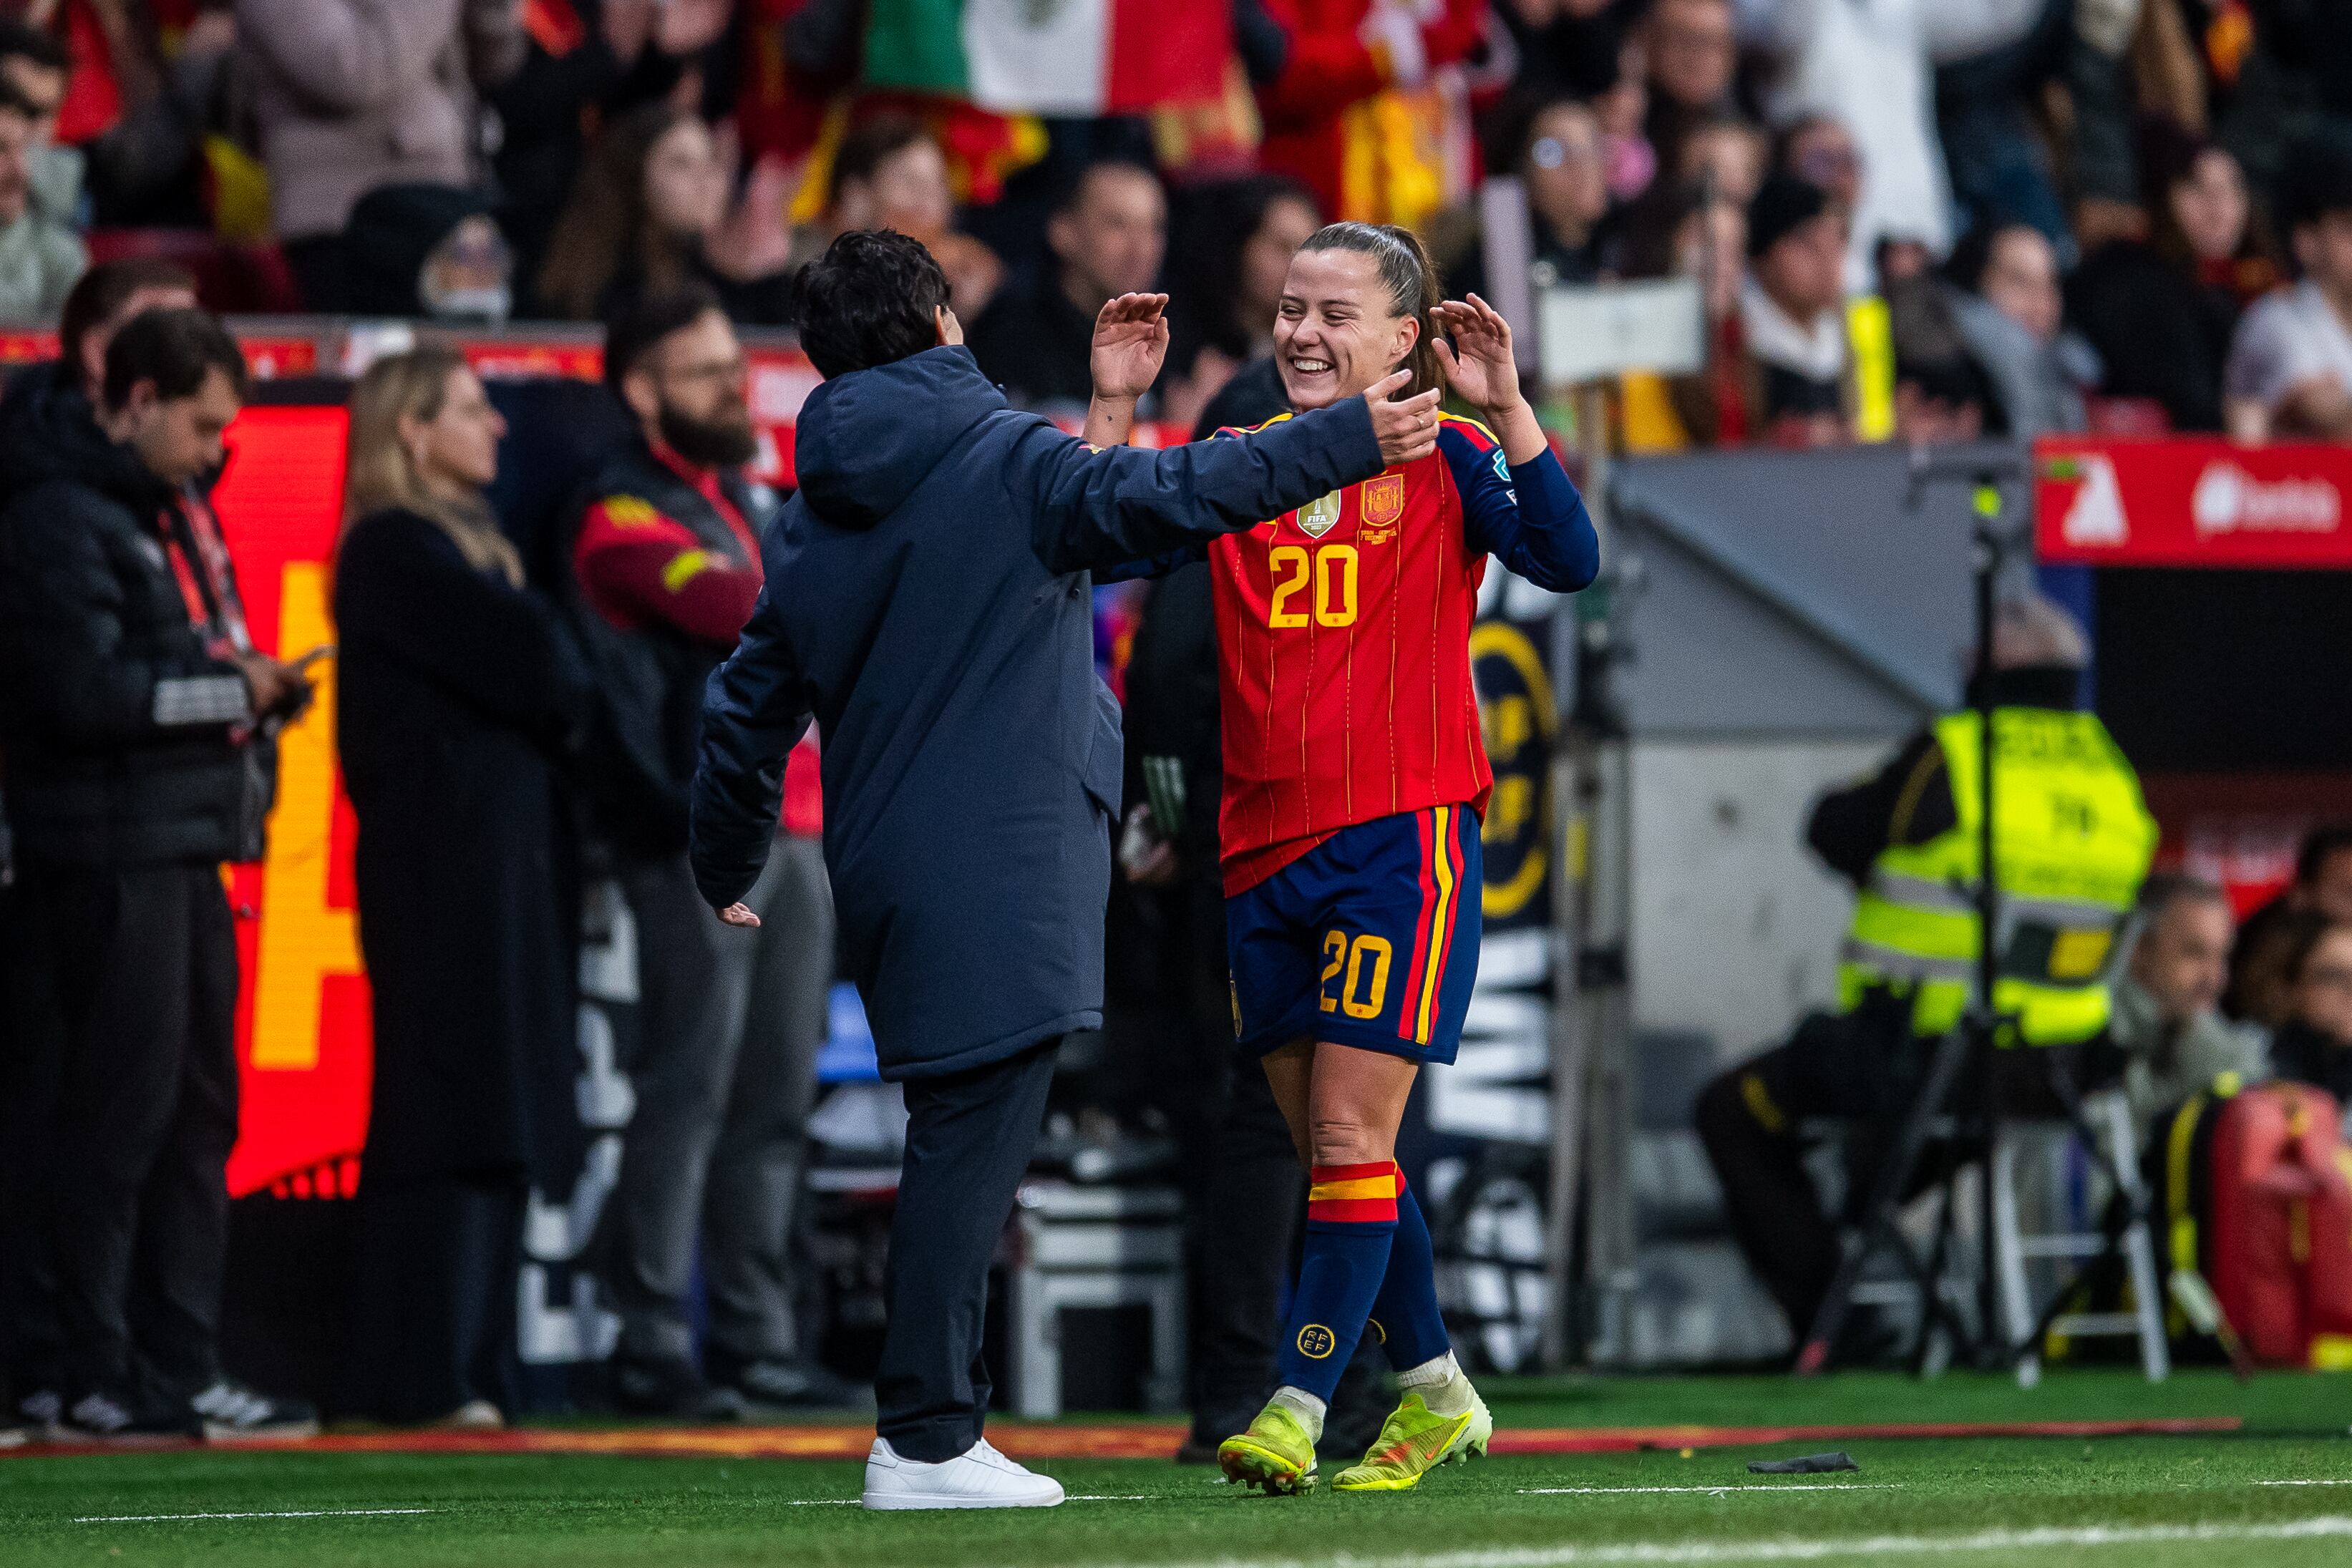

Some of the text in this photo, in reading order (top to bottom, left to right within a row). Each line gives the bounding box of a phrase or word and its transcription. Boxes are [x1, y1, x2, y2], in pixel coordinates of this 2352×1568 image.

[1307, 515, 1327, 523] FIFA
[1269, 545, 1359, 628] 20
[1320, 930, 1391, 1019] 20
[1307, 1330, 1328, 1341] RF
[1304, 1340, 1325, 1351] EF
